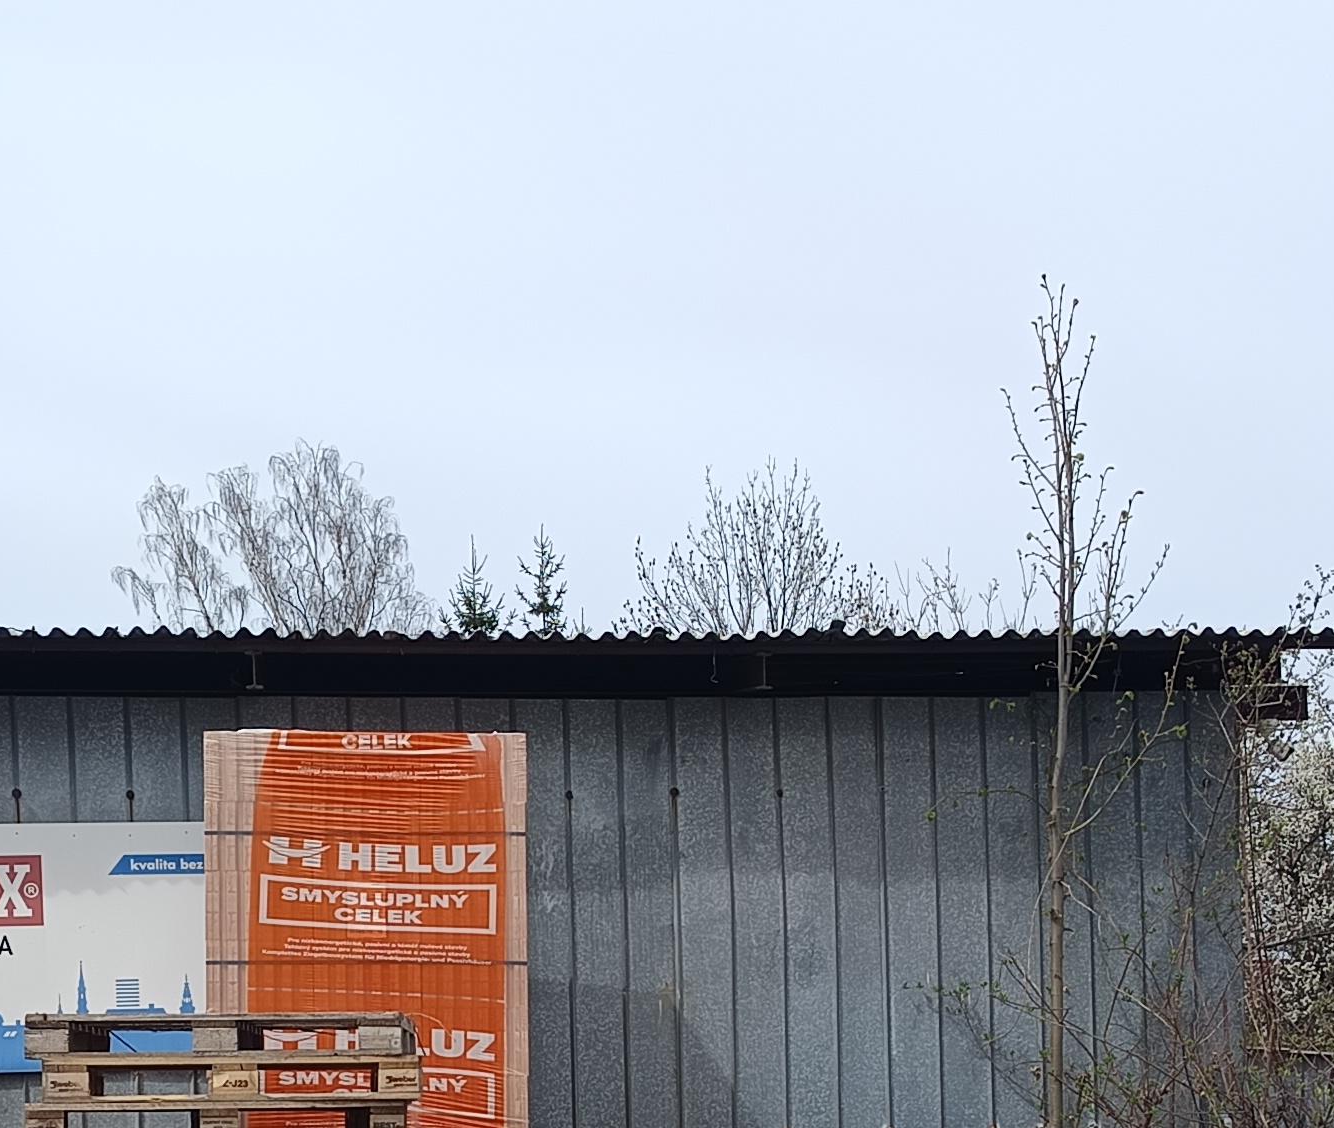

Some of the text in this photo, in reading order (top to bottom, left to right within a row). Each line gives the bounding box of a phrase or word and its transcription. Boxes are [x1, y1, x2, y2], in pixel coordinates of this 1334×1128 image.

[341, 733, 413, 750] CELEK
[130, 858, 176, 871] kvalita
[338, 842, 497, 874] HELUZ
[281, 886, 469, 909] SMYSLUPLNÝ
[333, 907, 423, 925] CELEK
